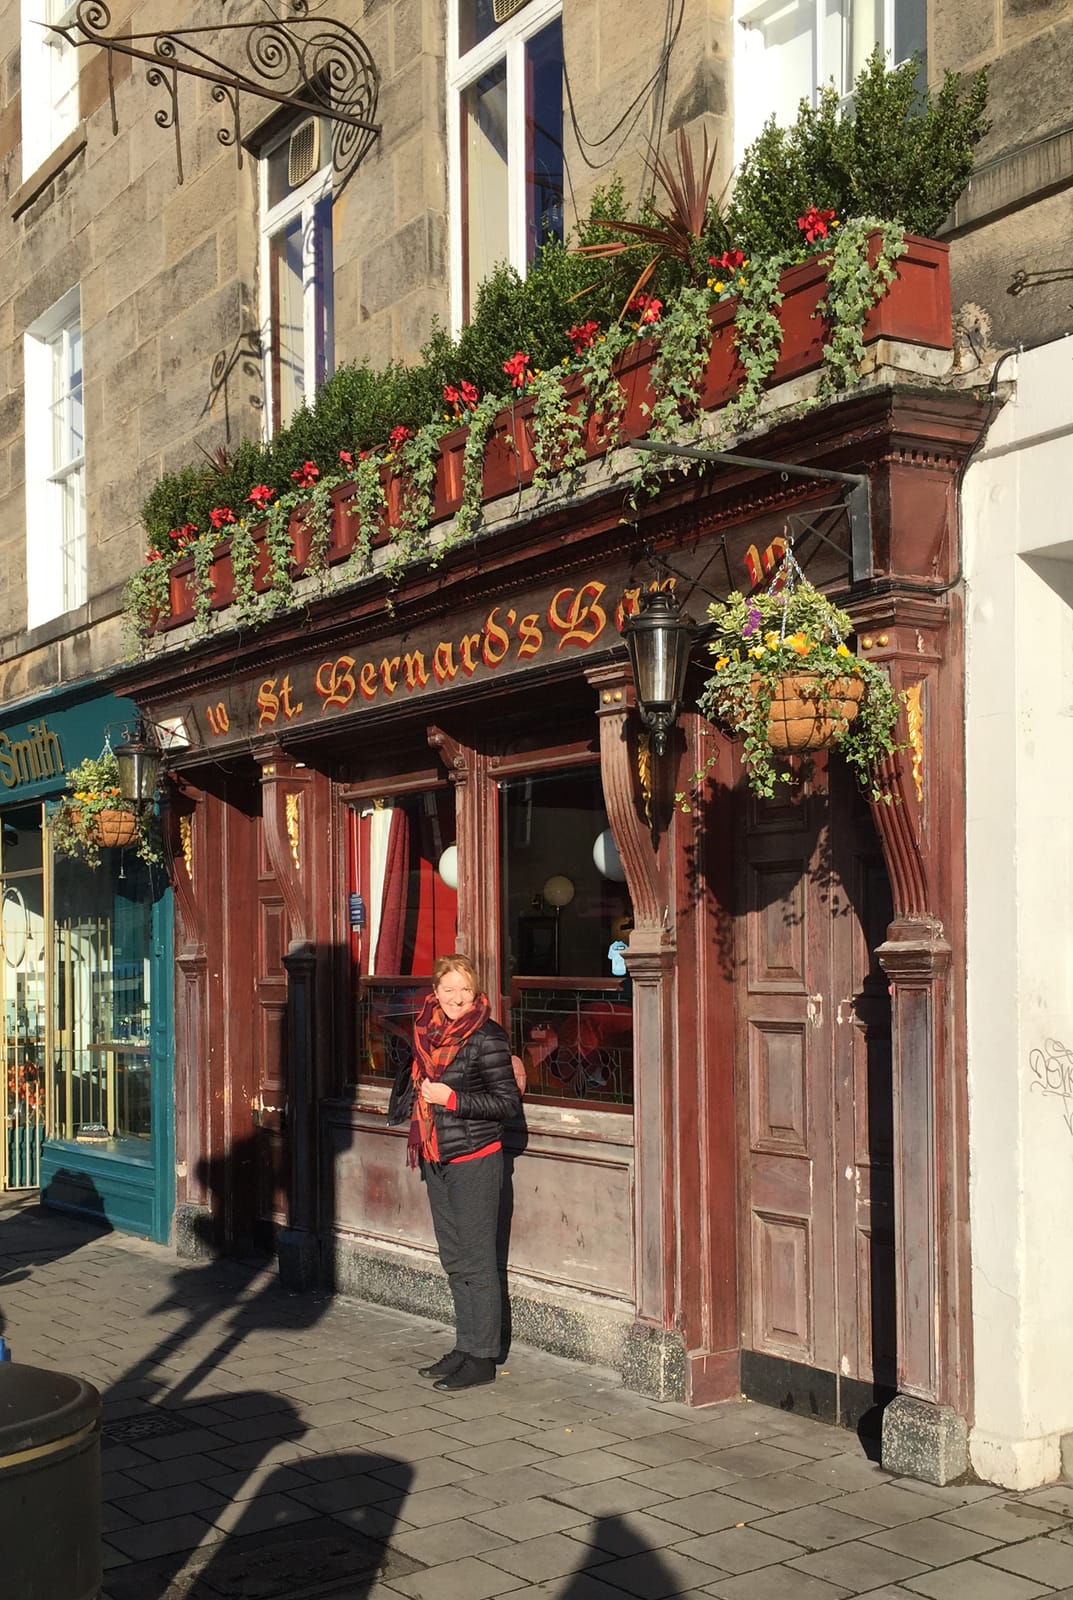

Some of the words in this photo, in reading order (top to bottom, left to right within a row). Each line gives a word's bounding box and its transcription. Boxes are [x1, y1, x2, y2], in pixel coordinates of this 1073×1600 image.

[206, 702, 229, 736] 10
[257, 674, 303, 733] St.
[315, 607, 543, 717] Bernard's
[547, 576, 677, 652] Ba
[0, 719, 64, 787] Smith
